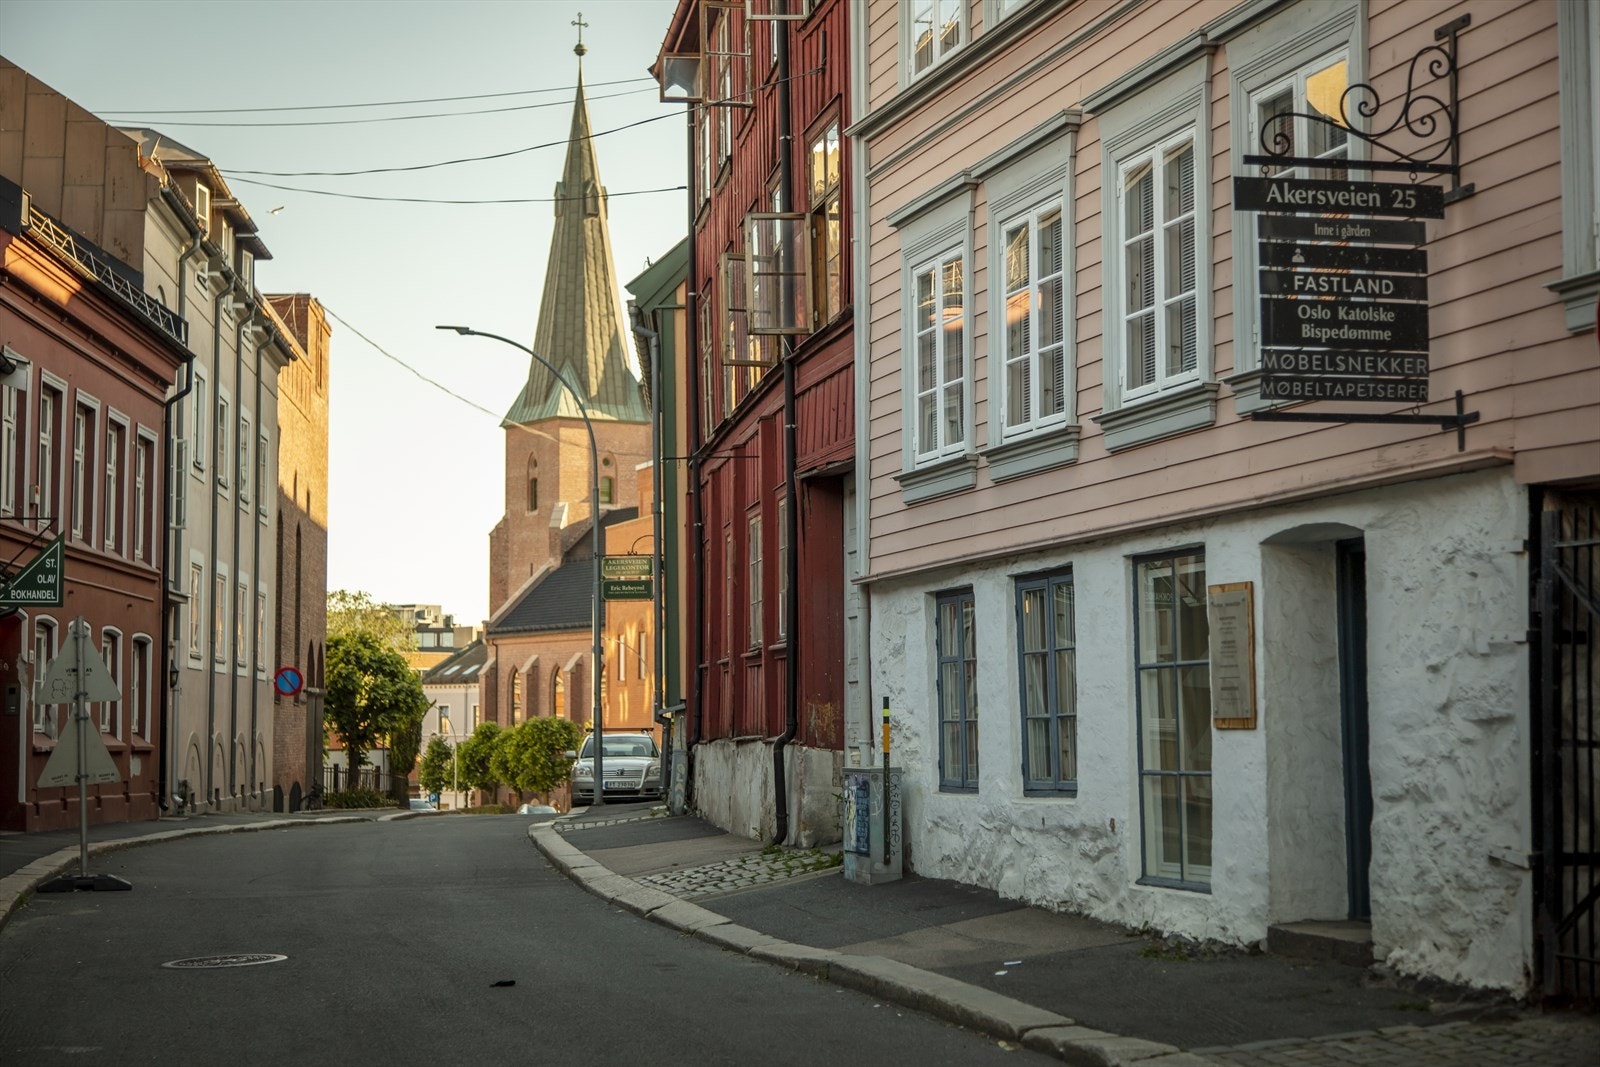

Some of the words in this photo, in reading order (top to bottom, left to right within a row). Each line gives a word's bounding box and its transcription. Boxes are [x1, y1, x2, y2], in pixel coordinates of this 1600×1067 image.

[1266, 182, 1381, 207] Akersveien
[1391, 190, 1417, 209] 25
[1314, 223, 1334, 236] Inne
[1336, 224, 1340, 237] i
[1341, 224, 1371, 239] gården
[1293, 275, 1394, 295] FASTLAND
[1297, 304, 1331, 320] Oslo
[1338, 306, 1396, 323] Katolske
[1301, 324, 1392, 342] Bispedømme
[1262, 353, 1428, 375] MØBELSNEKKER
[1260, 381, 1429, 399] MØBELTAPETSERER
[45, 558, 57, 568] ST.
[37, 574, 56, 584] OLAV
[10, 590, 56, 600] BOKHANDEL
